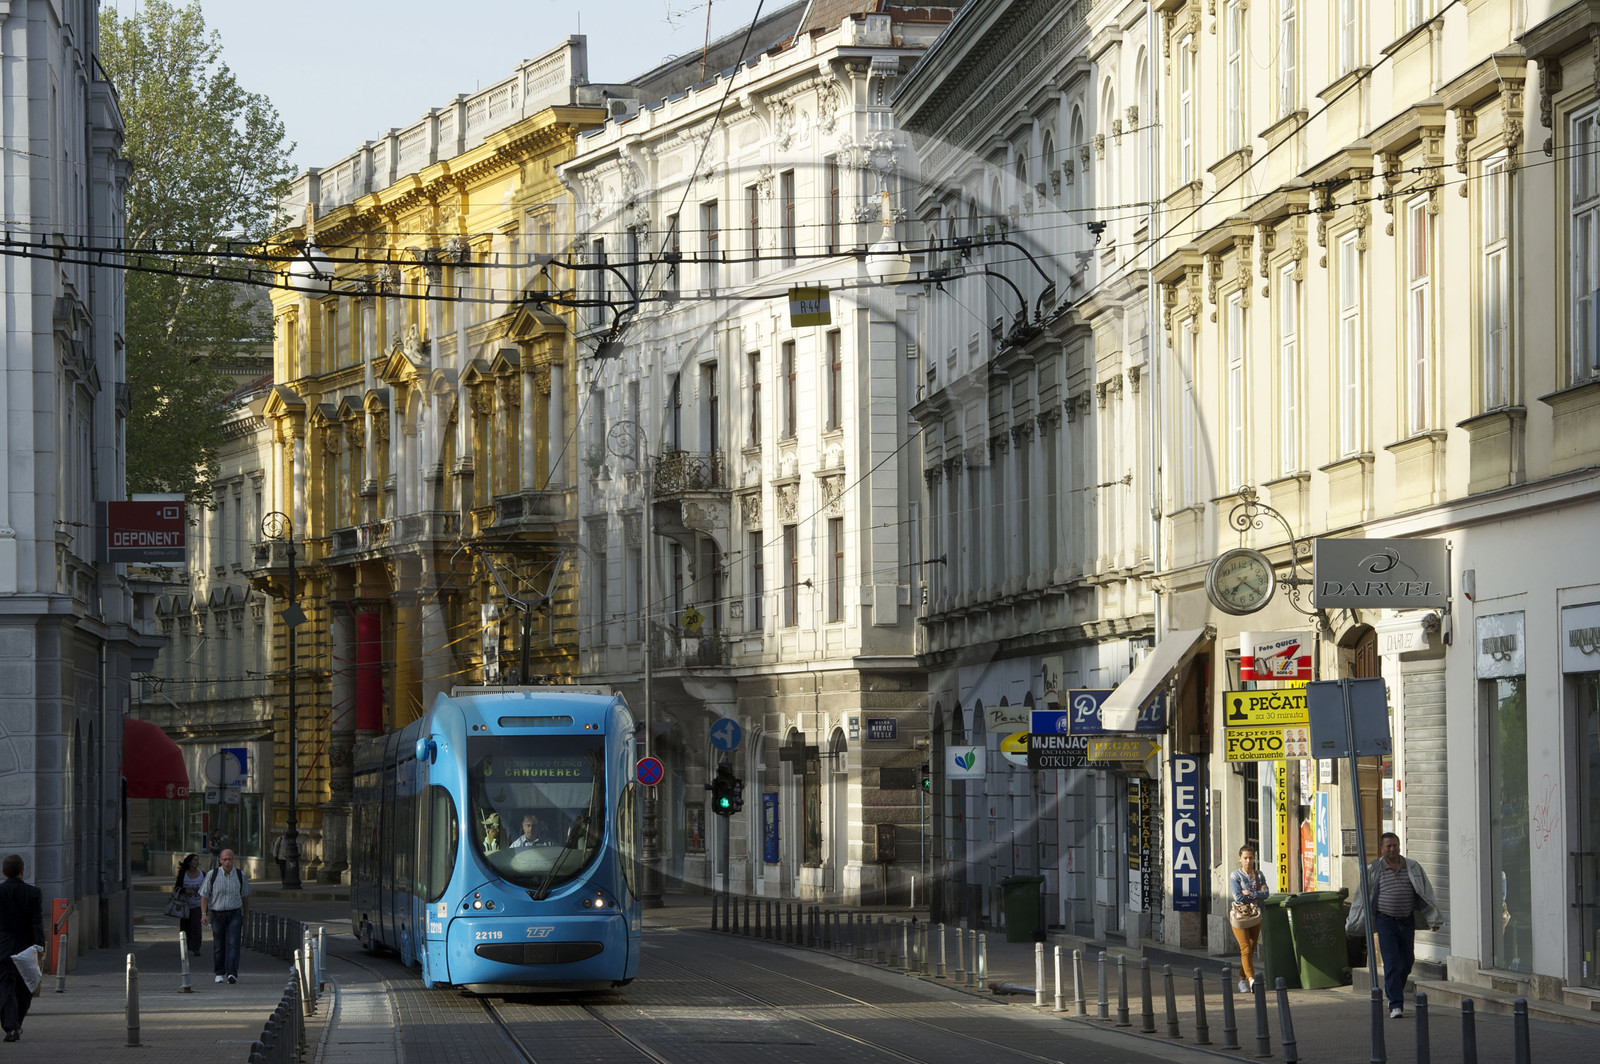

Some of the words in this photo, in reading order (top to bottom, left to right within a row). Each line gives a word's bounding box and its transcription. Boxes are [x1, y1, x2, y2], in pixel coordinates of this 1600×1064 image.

[113, 531, 180, 546] DEPONENT
[1320, 581, 1442, 597] DARVEL
[686, 614, 698, 624] 20
[1275, 638, 1297, 648] QUICK
[1386, 633, 1414, 651] DARVEL
[1249, 692, 1308, 710] PEČATI
[990, 710, 1029, 722] Penti
[1228, 737, 1282, 752] FOTO
[1040, 756, 1075, 767] OTKUP
[1174, 759, 1198, 897] PEČAT
[476, 931, 503, 940] 22119
[526, 927, 555, 938] ZET
